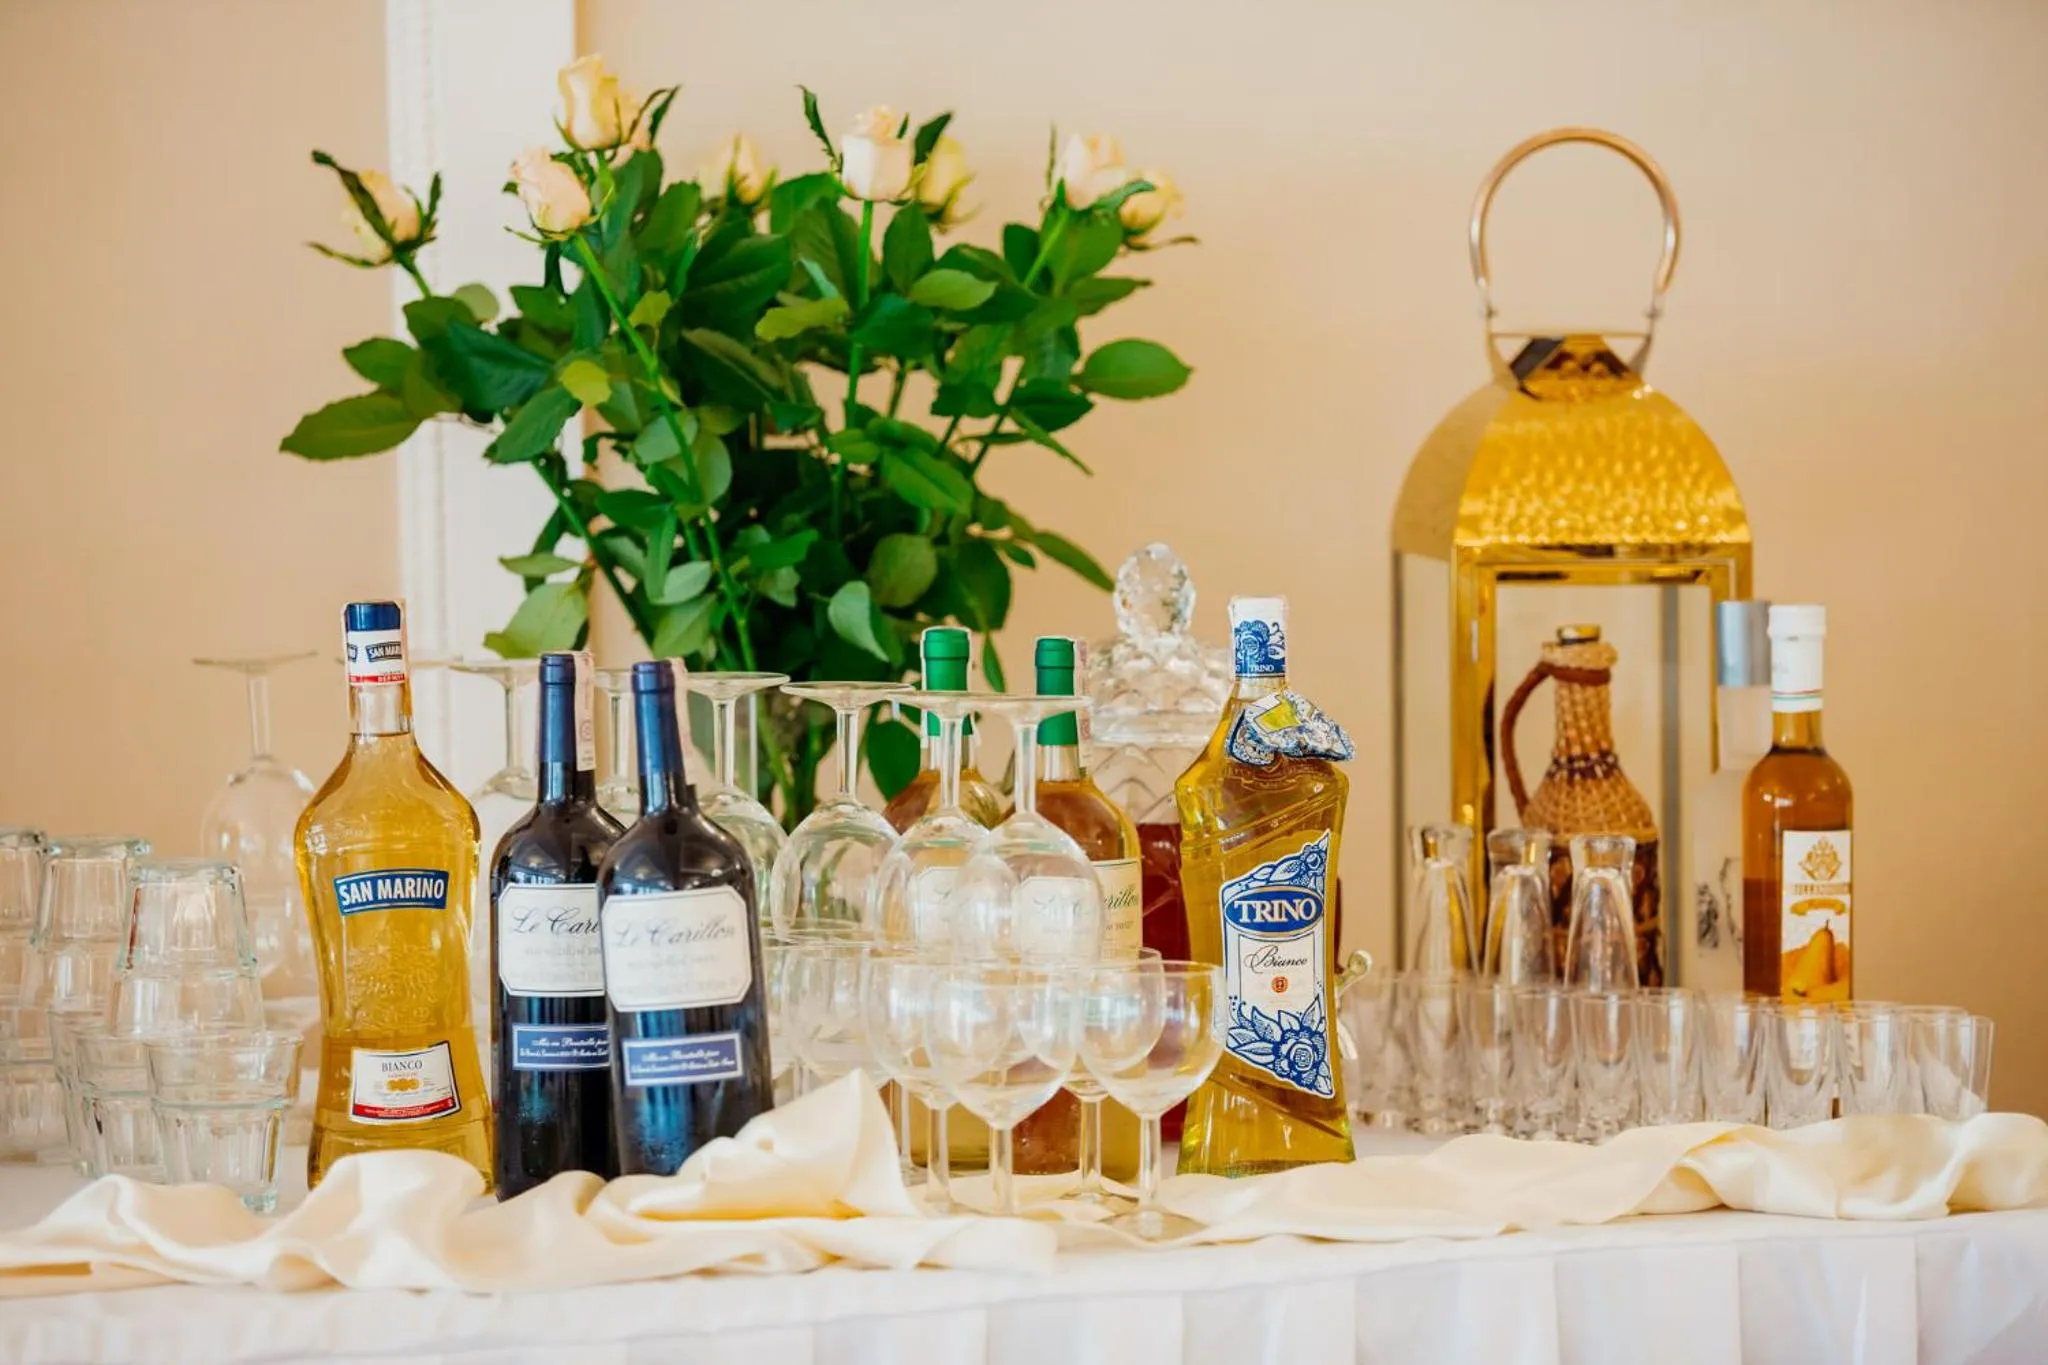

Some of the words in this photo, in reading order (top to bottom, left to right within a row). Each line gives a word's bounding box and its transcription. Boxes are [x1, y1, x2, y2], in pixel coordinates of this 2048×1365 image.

[339, 881, 374, 906] SAN
[377, 877, 445, 900] MARINO
[1234, 897, 1317, 923] TRINO
[645, 913, 736, 946] Carillon
[1243, 944, 1309, 975] Bianco
[382, 1059, 423, 1073] BIANCO
